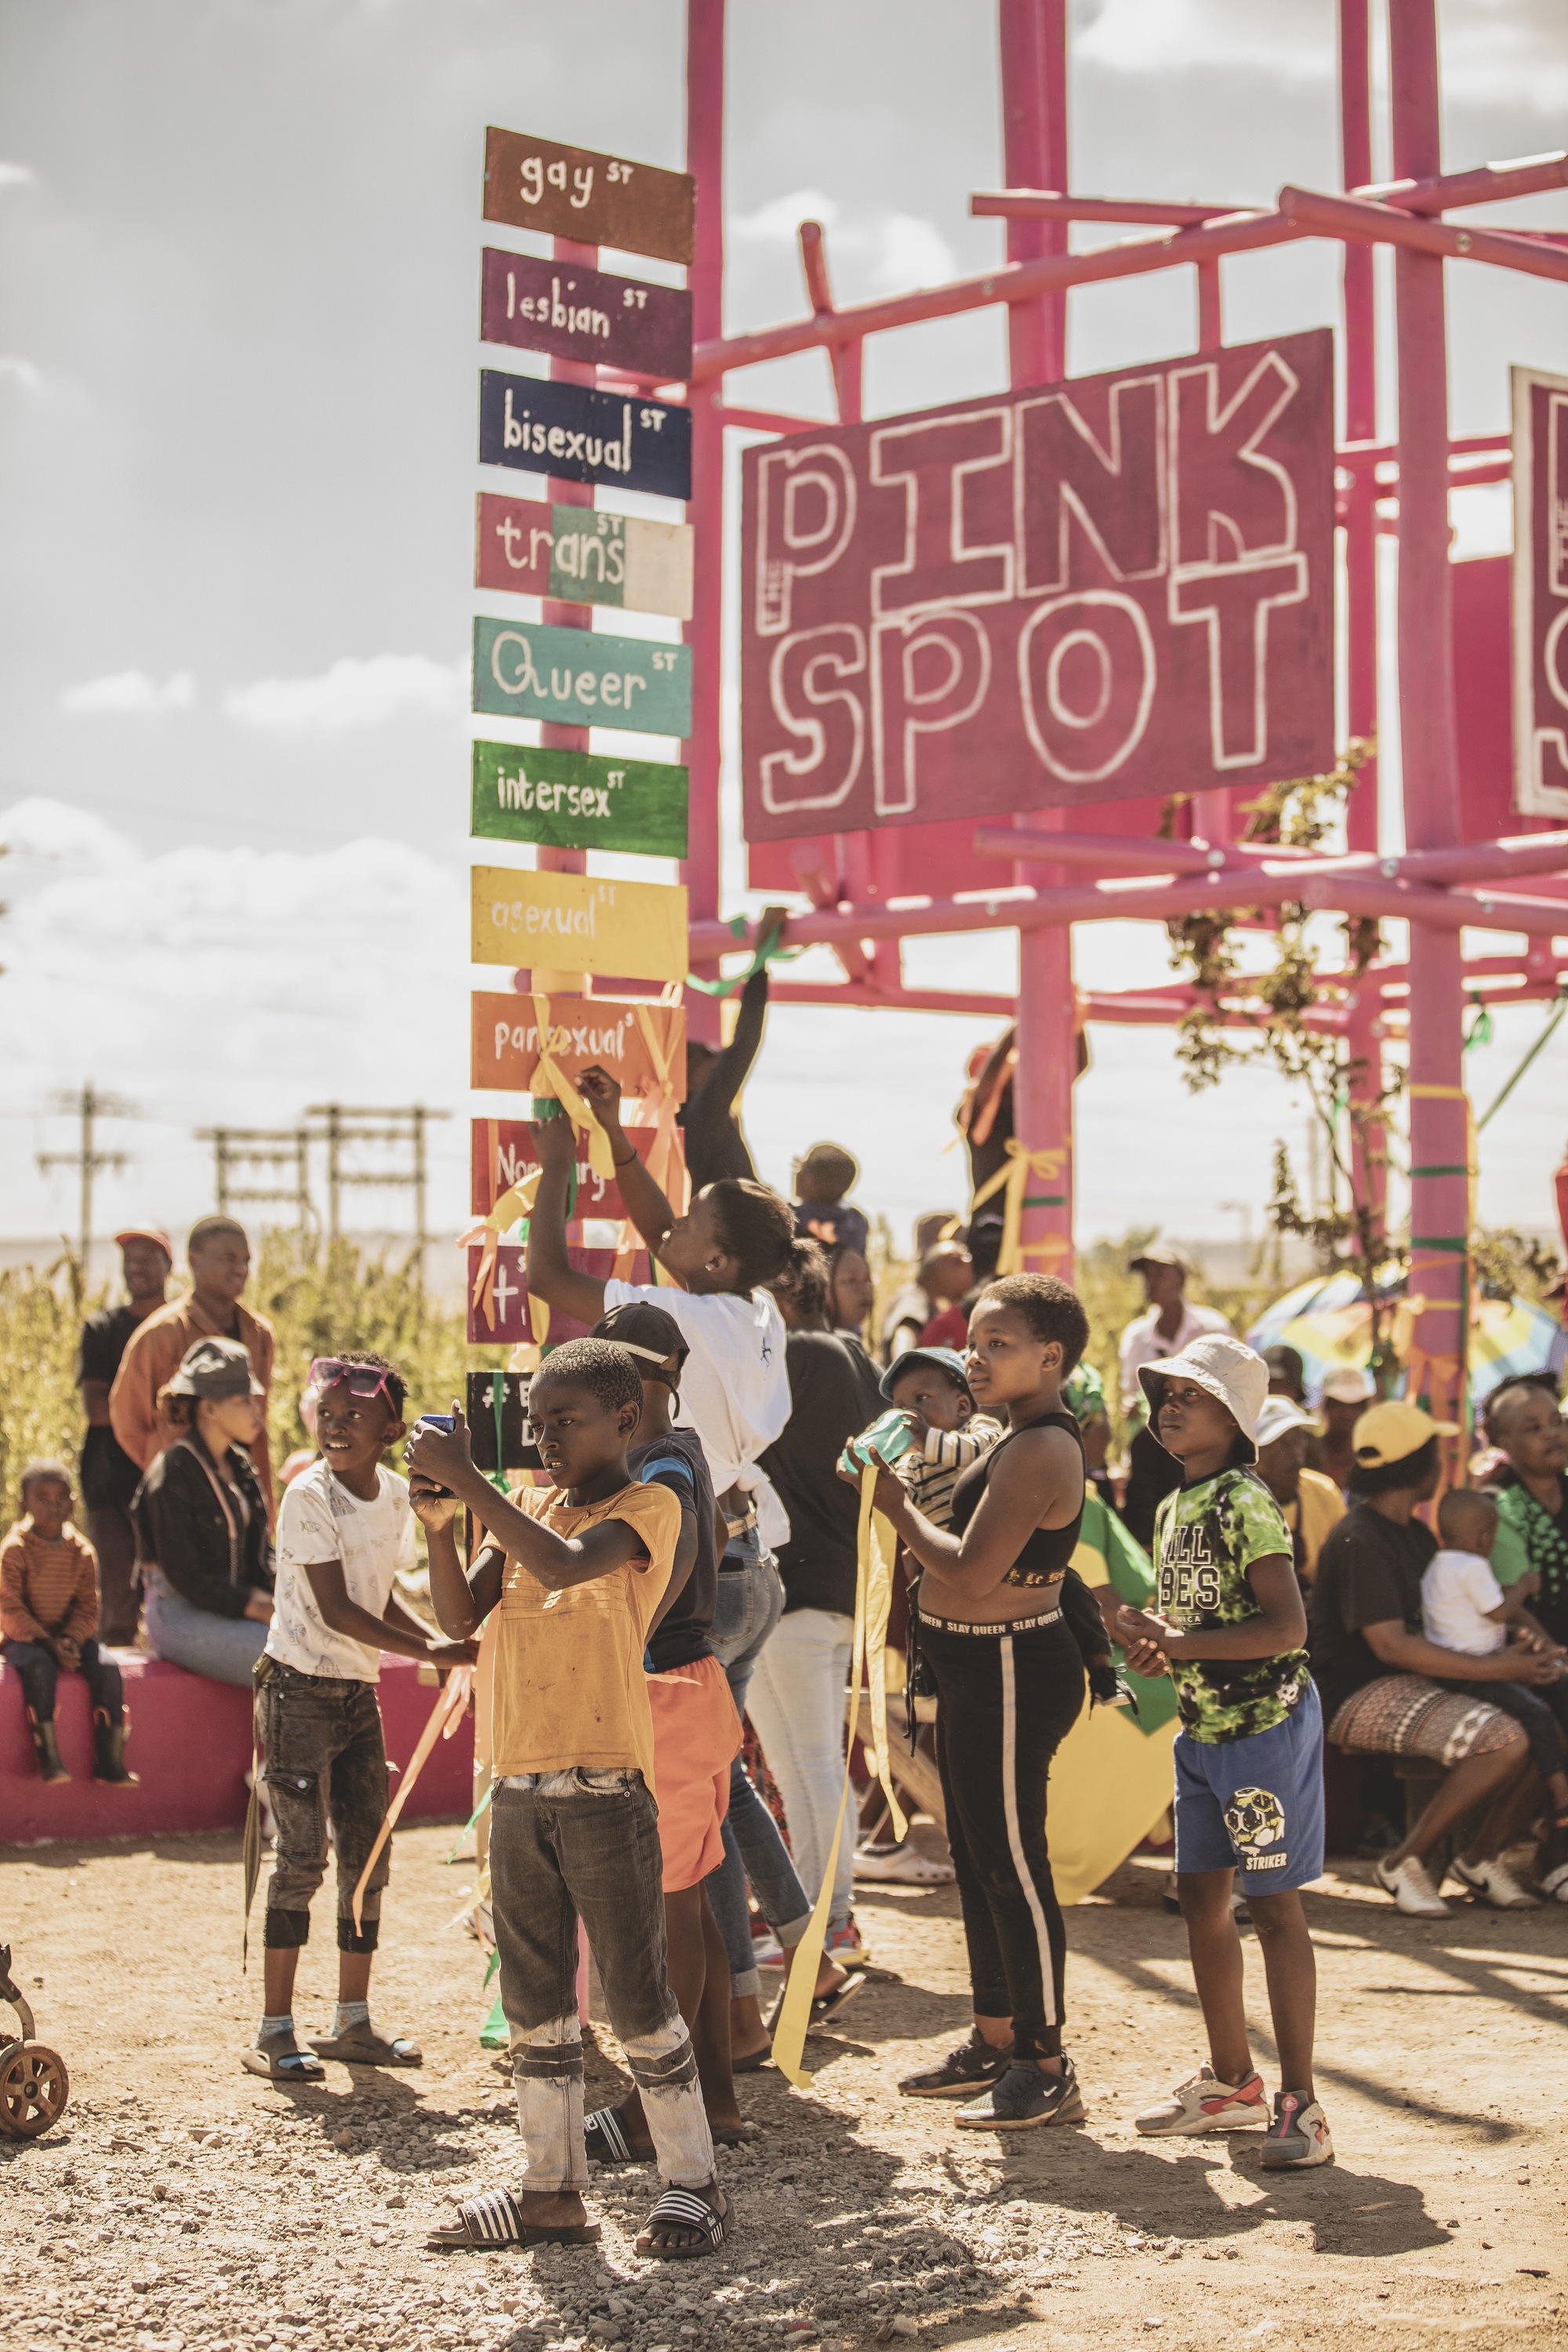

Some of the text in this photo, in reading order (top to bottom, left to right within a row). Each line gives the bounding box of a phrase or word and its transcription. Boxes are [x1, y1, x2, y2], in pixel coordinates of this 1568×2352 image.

[521, 157, 634, 208] gay ST
[506, 271, 648, 339] lesbian ST
[504, 389, 666, 473] bisexual ST
[757, 350, 1299, 636] PINK
[496, 514, 624, 584] trans ST
[491, 630, 677, 710] Queer ST
[760, 551, 1308, 816] SPOT
[497, 767, 626, 818] intersex ST
[492, 884, 617, 938] asexual ST
[921, 1613, 942, 1628] QUEEN
[947, 1622, 970, 1634] SLAY
[972, 1625, 1006, 1636] QUEEN
[1012, 1618, 1036, 1632] SLAY
[1037, 1610, 1058, 1627] QUEEN
[1245, 1853, 1287, 1871] STRIKER
